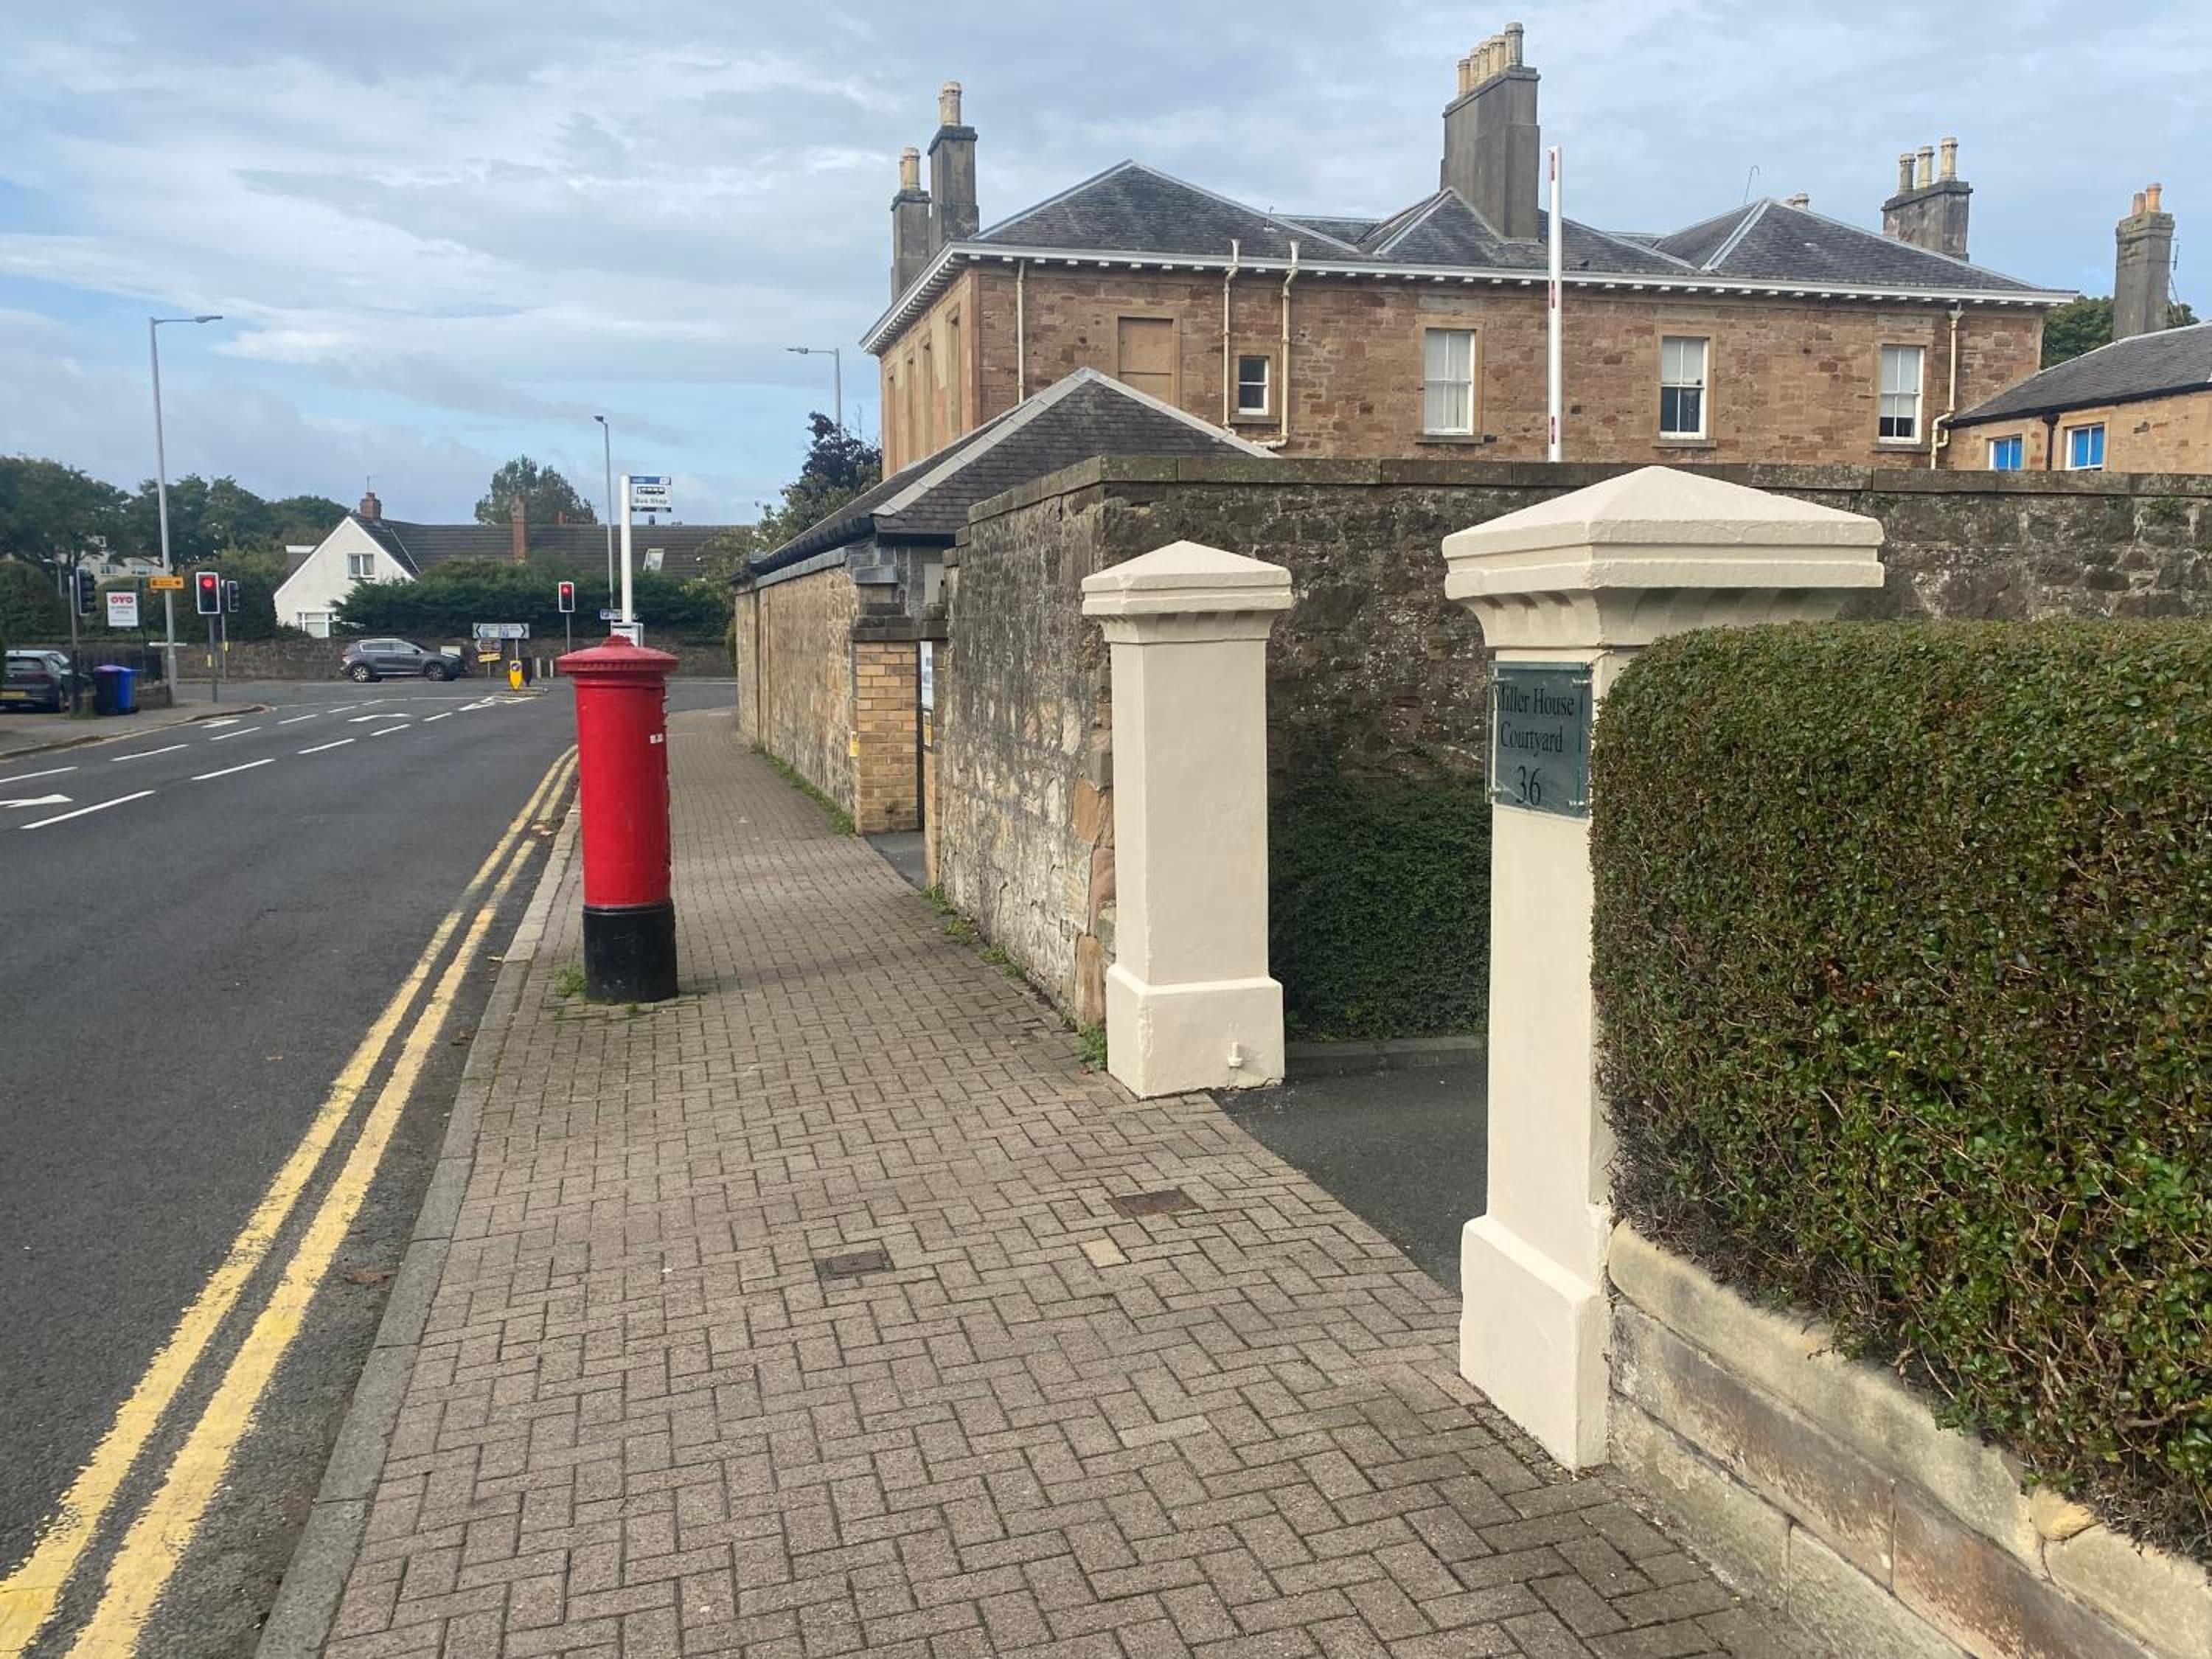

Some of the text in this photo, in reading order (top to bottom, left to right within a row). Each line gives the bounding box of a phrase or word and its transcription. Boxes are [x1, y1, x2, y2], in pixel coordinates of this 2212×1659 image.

[111, 595, 134, 604] OYO
[1534, 688, 1575, 717] House
[1500, 722, 1563, 757] Courtyard
[1516, 765, 1541, 806] 36
